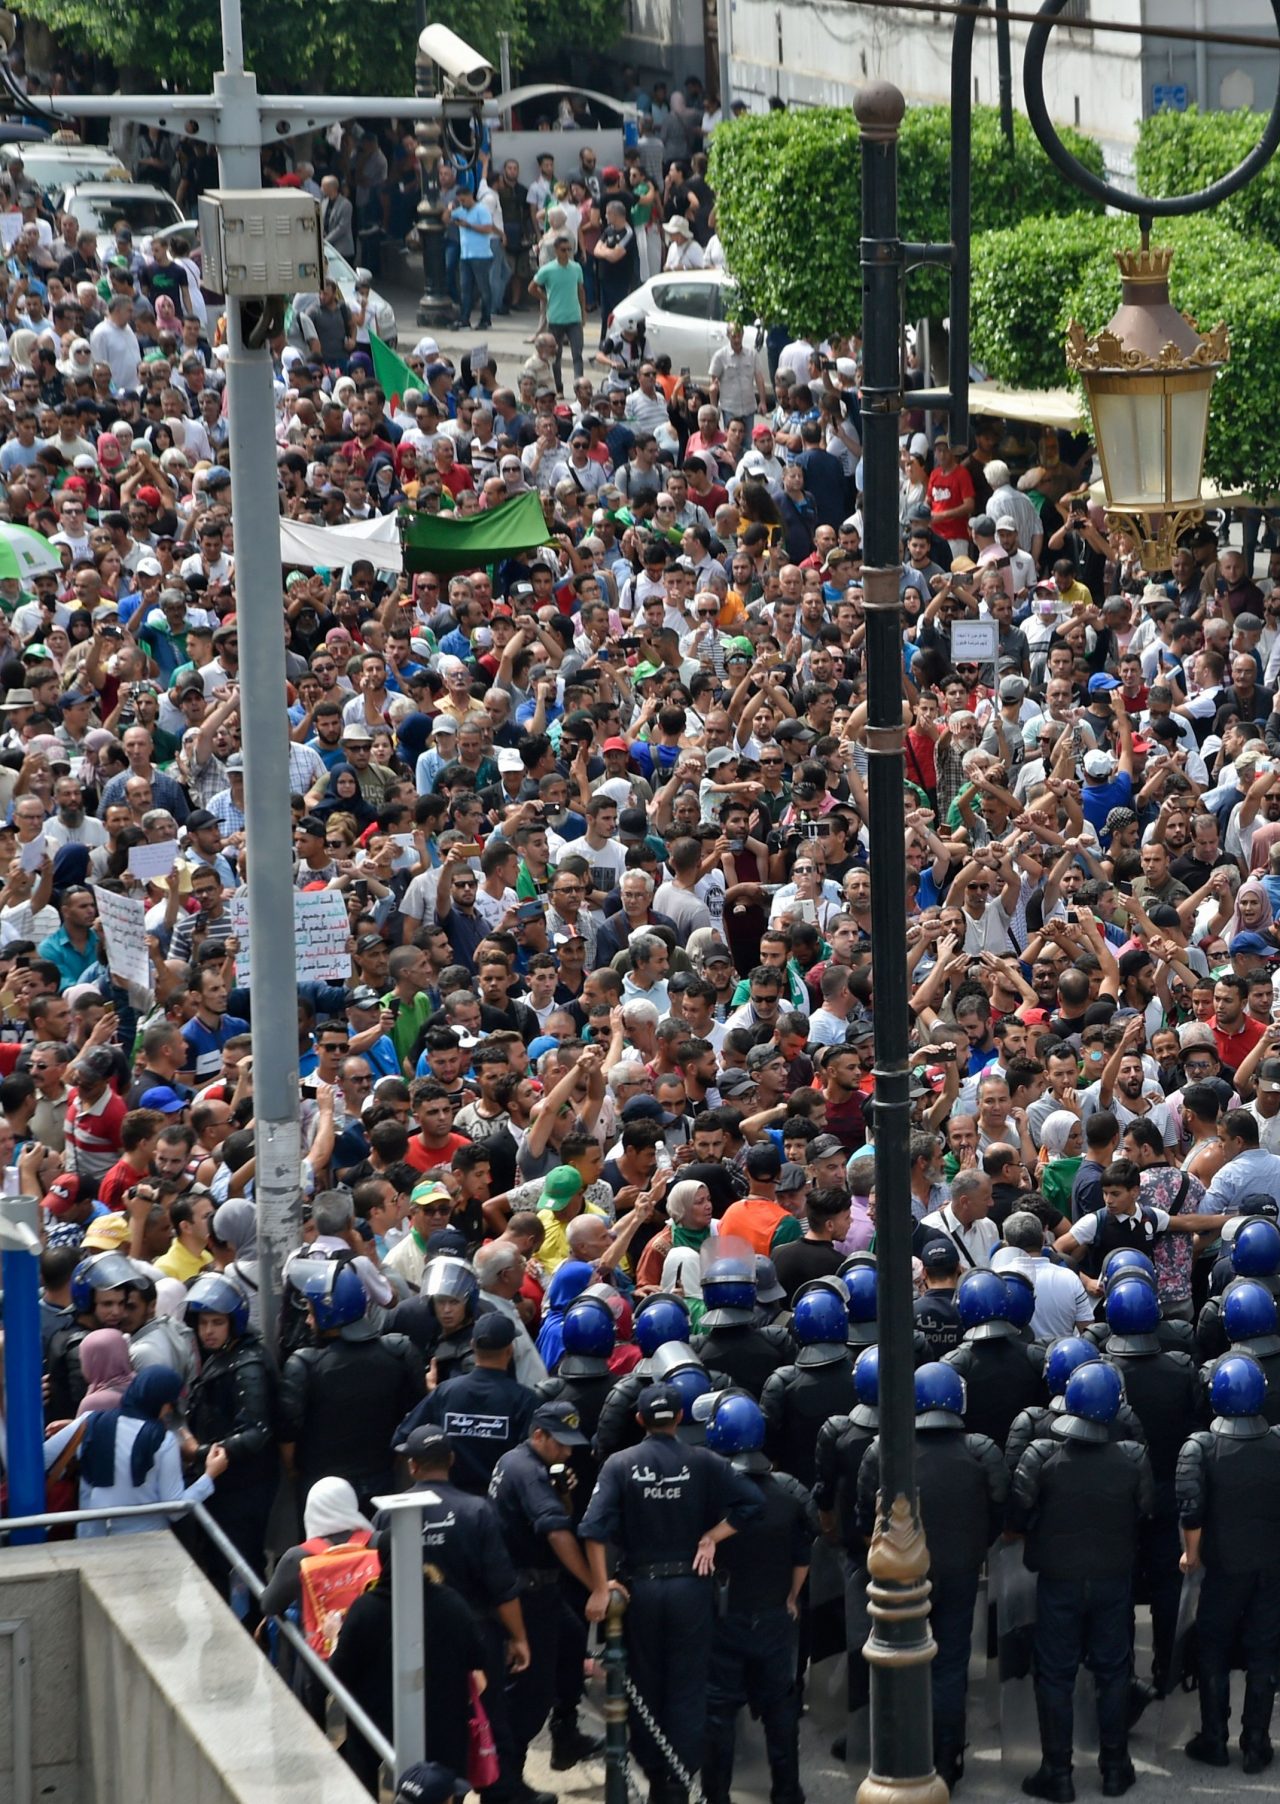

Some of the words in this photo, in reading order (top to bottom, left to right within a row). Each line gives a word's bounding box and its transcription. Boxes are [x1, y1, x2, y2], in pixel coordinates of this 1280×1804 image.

[916, 1314, 958, 1331] رطة
[450, 1414, 504, 1430] شرطة
[460, 1427, 492, 1438] POLICE
[631, 1464, 690, 1483] شرطة
[643, 1486, 681, 1500] POLICE
[422, 1533, 446, 1546] LICE
